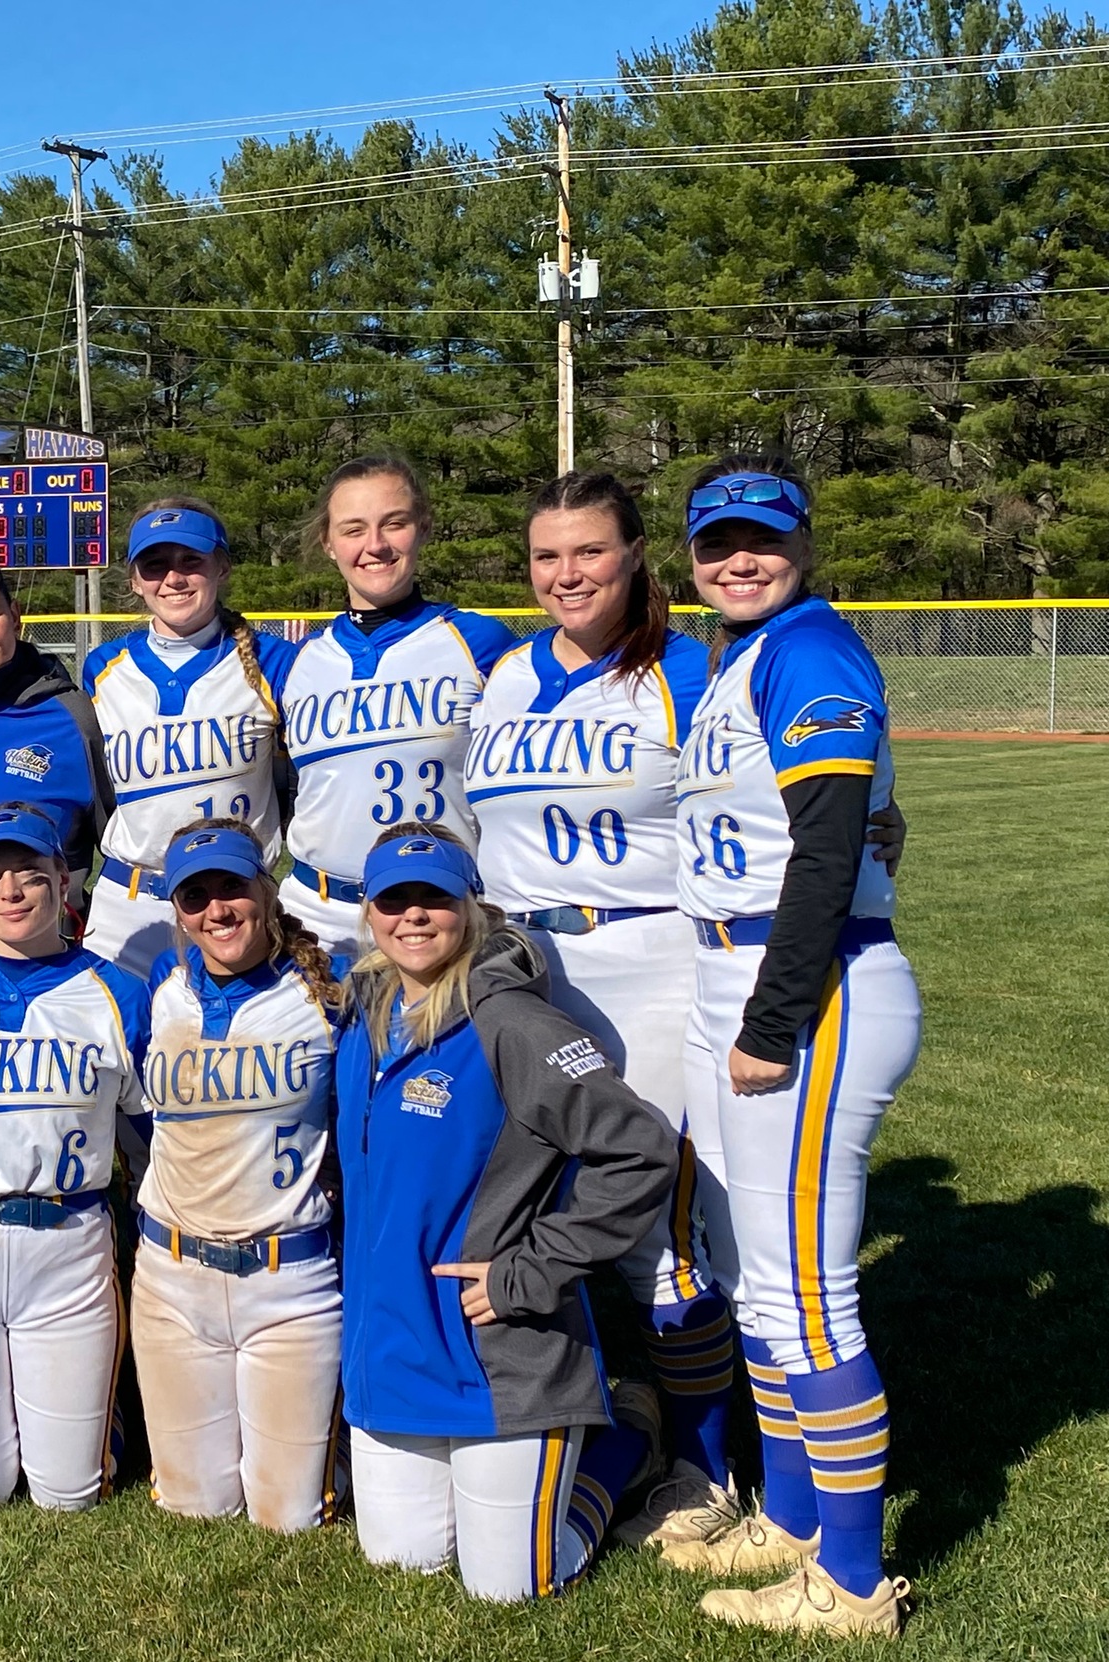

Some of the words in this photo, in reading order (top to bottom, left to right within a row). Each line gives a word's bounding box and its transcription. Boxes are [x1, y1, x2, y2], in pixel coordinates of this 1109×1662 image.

[25, 428, 105, 460] HAWKS
[17, 503, 23, 514] 6
[36, 502, 43, 513] 7
[47, 474, 76, 488] OUT
[73, 501, 103, 512] RUNS
[87, 542, 101, 564] 9
[5, 766, 43, 783] SOFTBALL
[465, 719, 639, 781] OCKING
[371, 759, 446, 826] 33
[542, 803, 629, 866] 00
[687, 813, 747, 880] 16
[145, 1039, 311, 1106] OCKING
[55, 1129, 88, 1193] 6
[272, 1121, 304, 1190] 5
